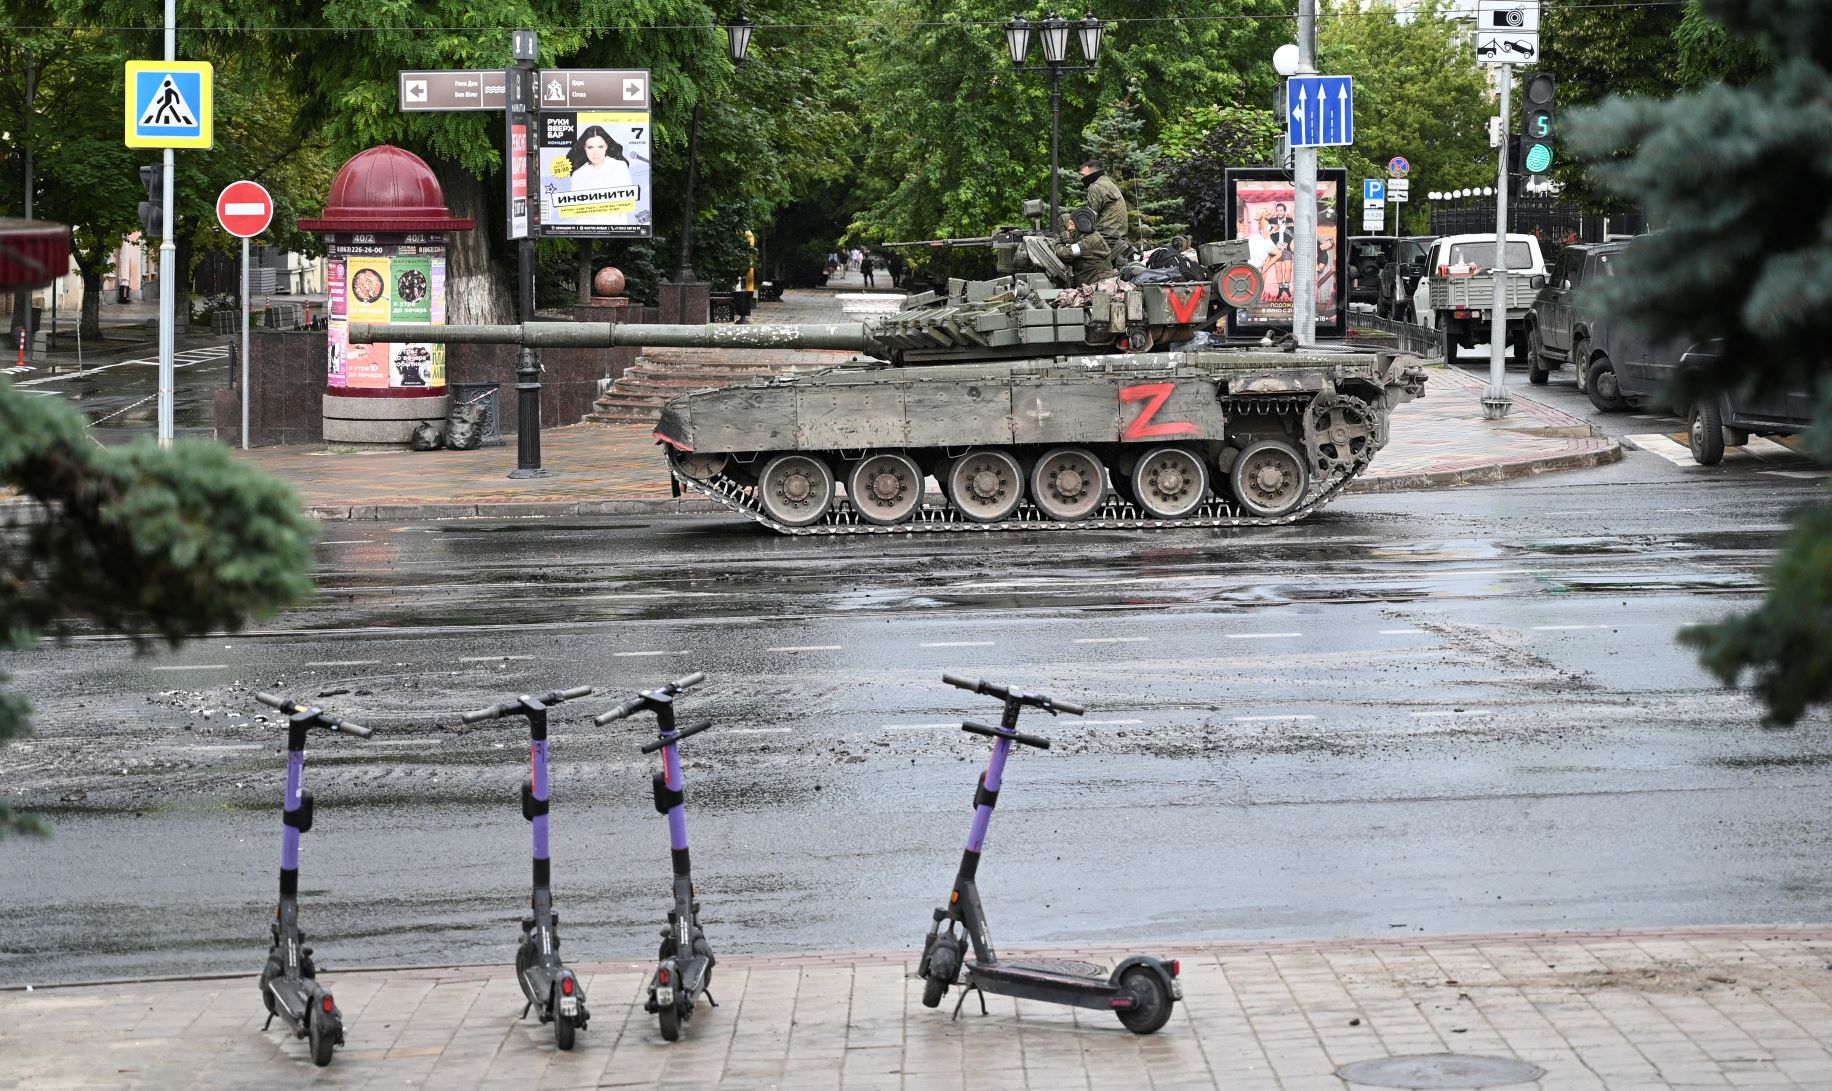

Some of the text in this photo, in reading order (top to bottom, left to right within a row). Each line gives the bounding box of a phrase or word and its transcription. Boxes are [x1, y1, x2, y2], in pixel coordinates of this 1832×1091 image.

[547, 118, 569, 126] РУКИ
[1537, 116, 1549, 135] 5
[547, 131, 564, 139] БАР
[631, 127, 644, 139] 7
[1370, 181, 1382, 198] P
[558, 189, 635, 204] ИНФИНИТИ
[354, 234, 374, 243] 40/2
[406, 234, 425, 243] 40/1
[1166, 285, 1205, 324] V
[1119, 383, 1200, 438] Z
